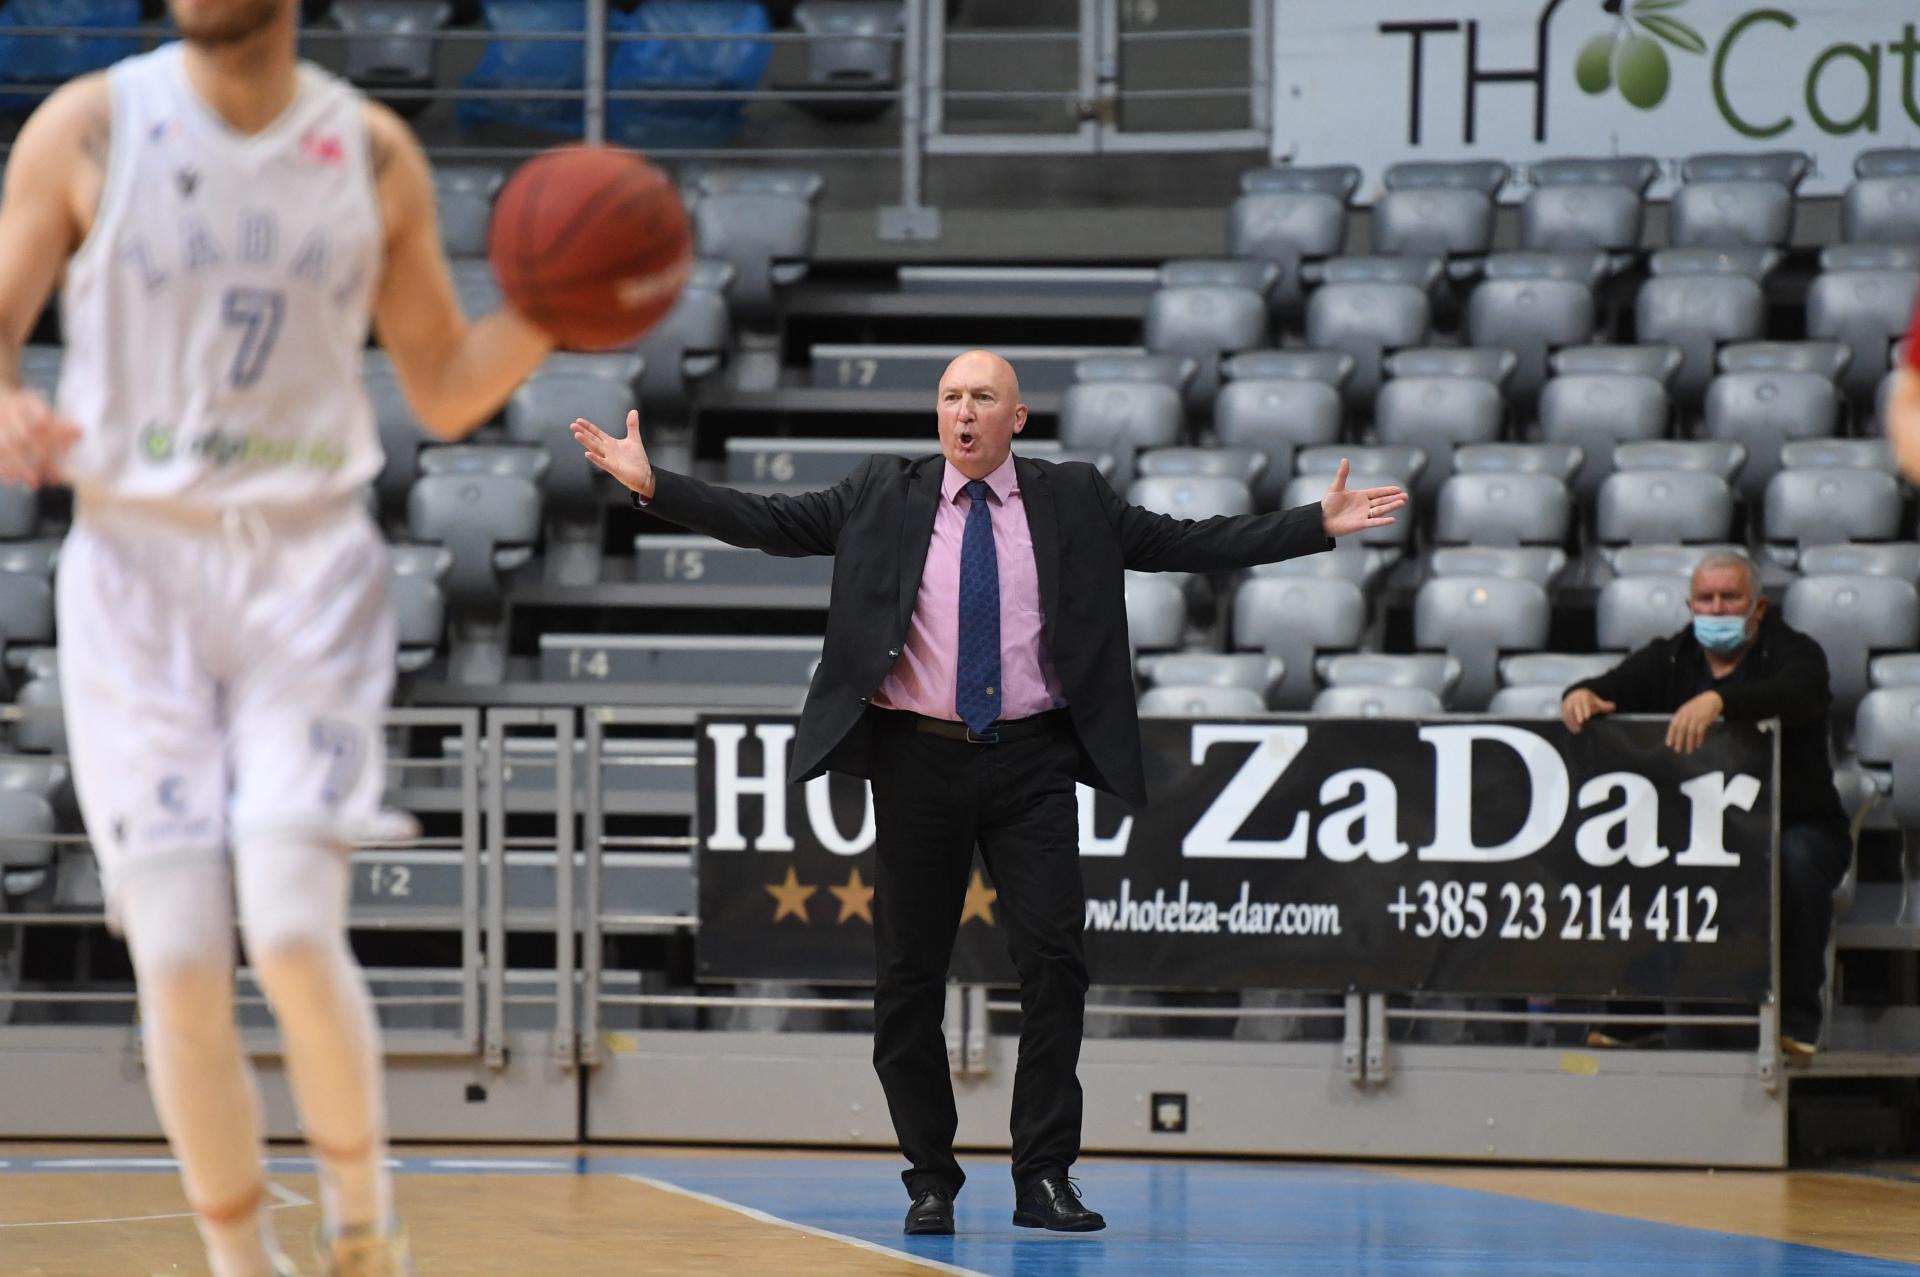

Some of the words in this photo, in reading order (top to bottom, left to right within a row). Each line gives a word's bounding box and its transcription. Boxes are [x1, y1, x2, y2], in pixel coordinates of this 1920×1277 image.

[221, 285, 288, 391] 7
[1182, 724, 1761, 868] ZaDar
[1387, 879, 1489, 940] +385
[1499, 881, 1548, 941] 23
[1559, 882, 1634, 942] 214
[1644, 884, 1720, 944] 412
